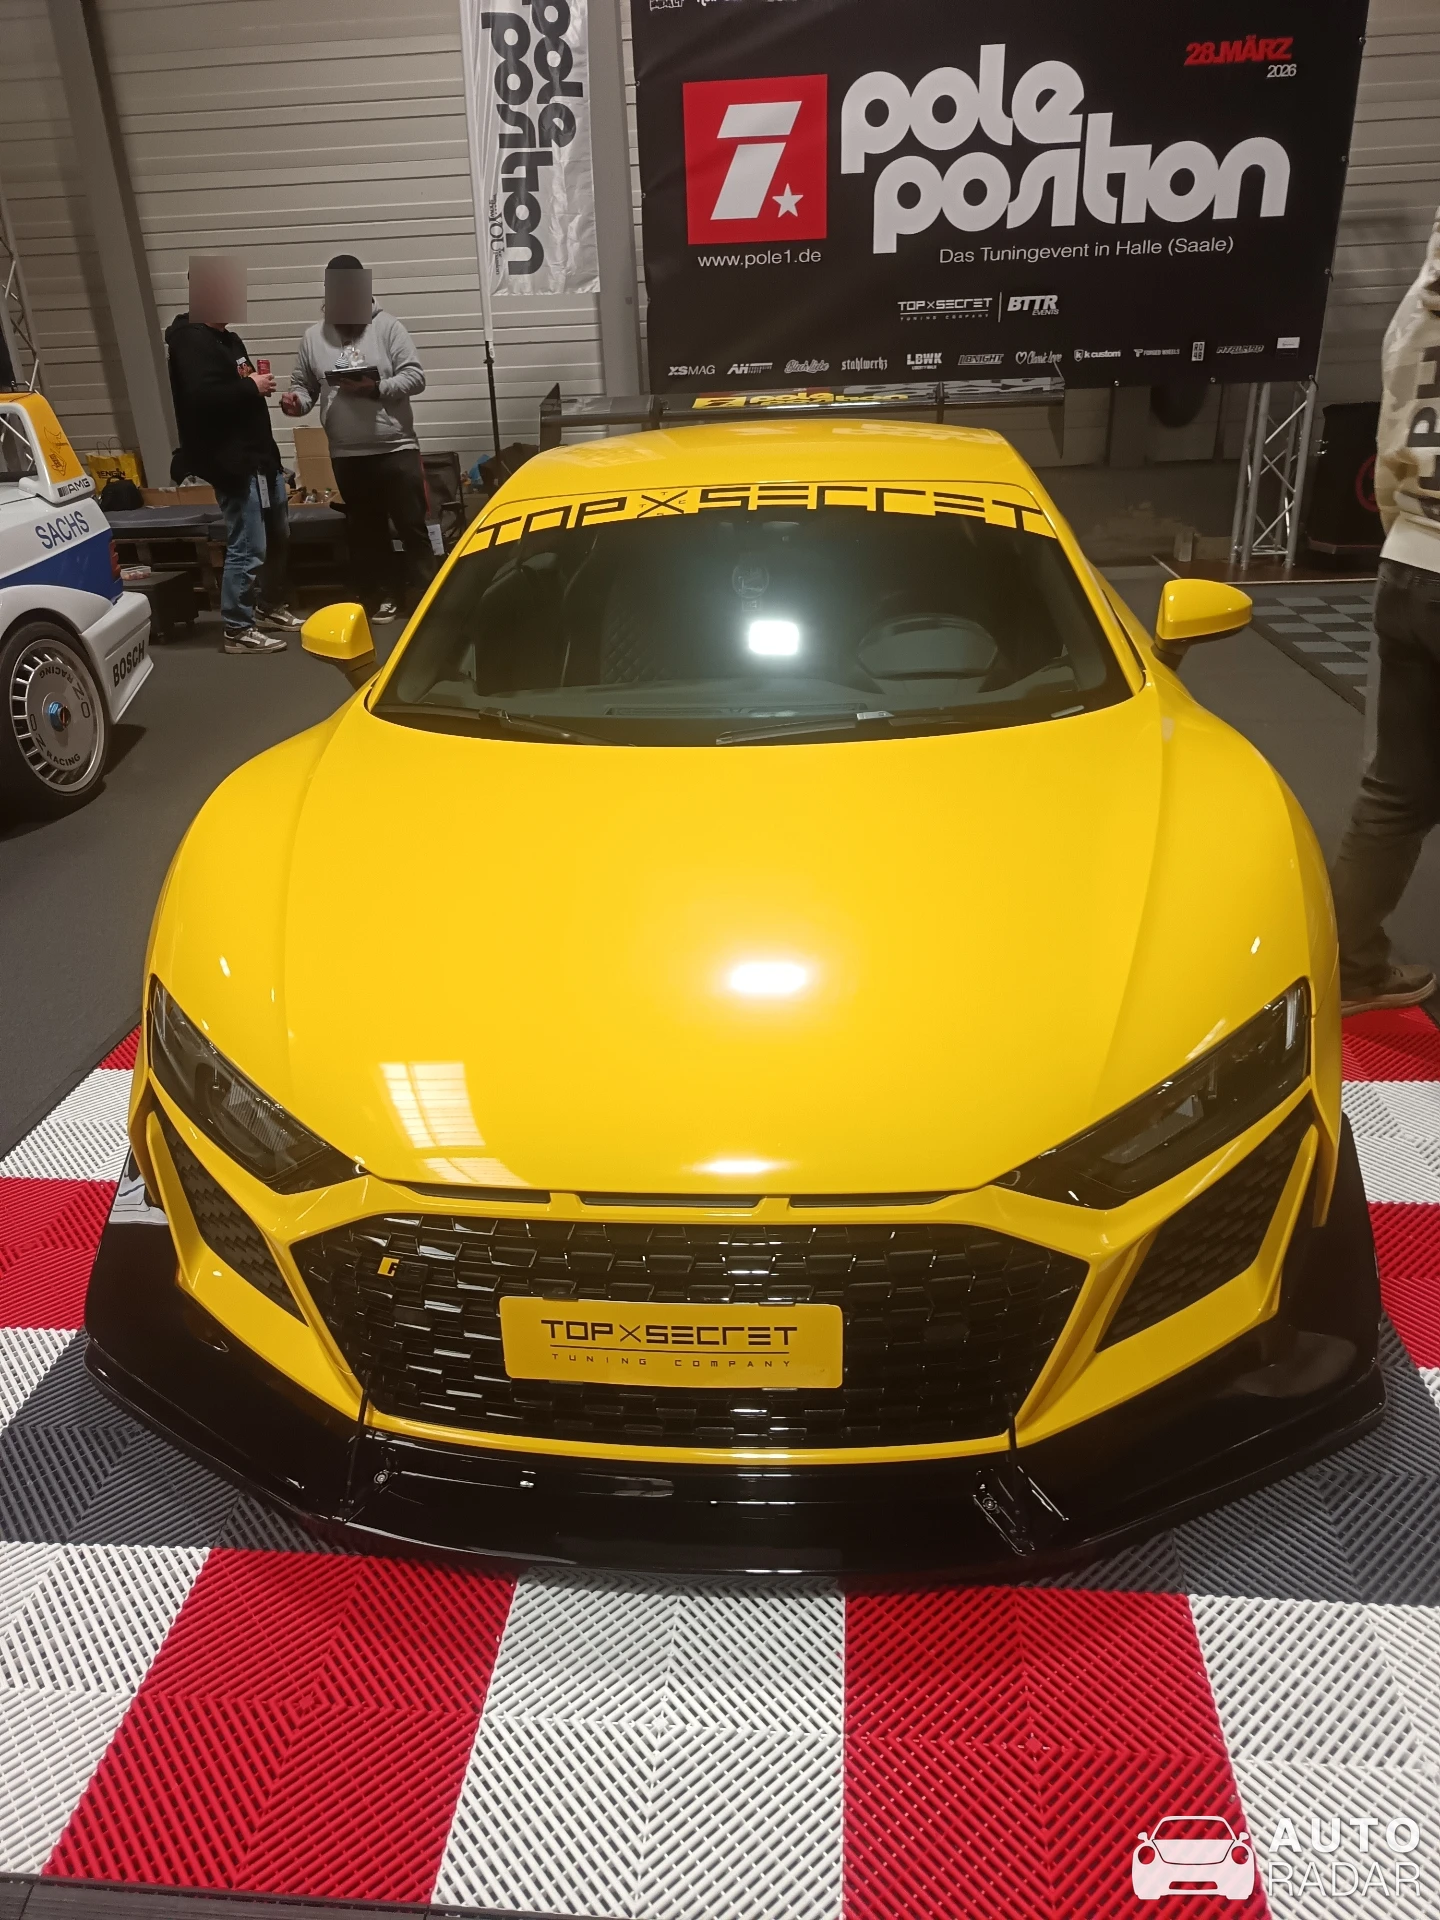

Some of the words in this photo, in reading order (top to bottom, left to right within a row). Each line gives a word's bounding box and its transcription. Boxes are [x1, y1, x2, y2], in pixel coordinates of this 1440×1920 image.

[1266, 64, 1297, 78] 2026
[841, 43, 1085, 174] pole
[481, 12, 554, 275] position
[873, 112, 1291, 254] position
[697, 248, 822, 268] www.pole1.de
[939, 247, 975, 264] Das
[981, 241, 1090, 265] Tuningevent
[1094, 242, 1111, 258] in
[1116, 238, 1163, 257] Halle
[1167, 236, 1236, 257] (Saale)
[1007, 295, 1058, 311] BTTR
[1032, 308, 1060, 316] EVENTS
[906, 352, 942, 366] LBWK
[1091, 350, 1121, 359] custom
[69, 478, 91, 494] AMG
[35, 510, 90, 549] SACHS
[113, 640, 145, 687] BOSCH
[39, 666, 74, 683] RACING
[46, 753, 81, 766] RACING
[552, 1353, 646, 1366] TUNING
[674, 1359, 790, 1368] COMPANY
